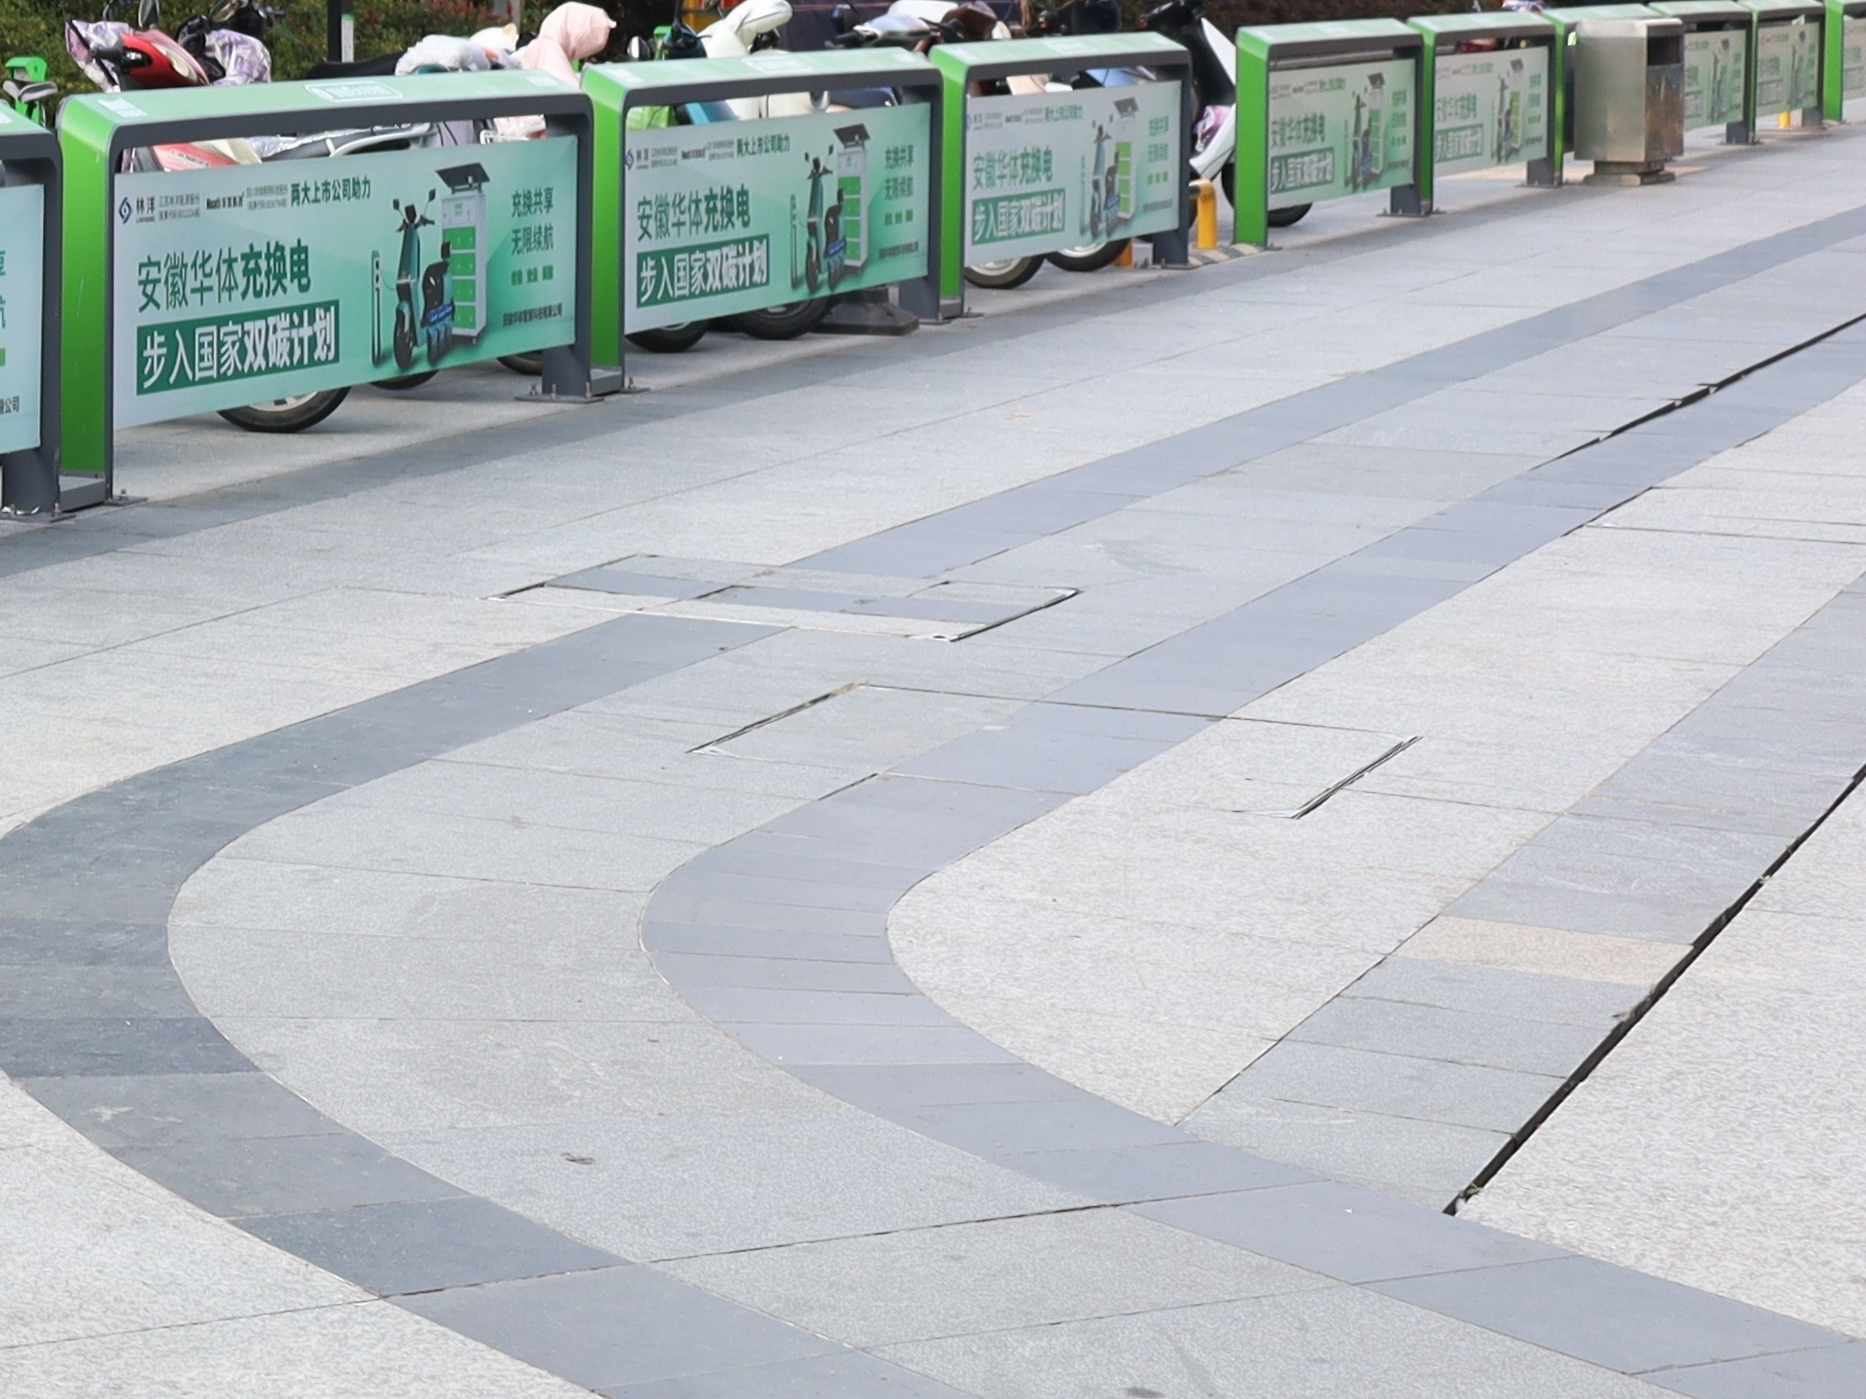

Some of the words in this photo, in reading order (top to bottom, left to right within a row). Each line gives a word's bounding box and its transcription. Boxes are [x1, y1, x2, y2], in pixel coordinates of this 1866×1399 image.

[289, 174, 372, 207] 两大上市公司助力
[137, 237, 312, 315] 安徽华体充换电
[640, 238, 768, 304] 步入国家双碳计划
[142, 308, 338, 391] 步入国家双碳计划
